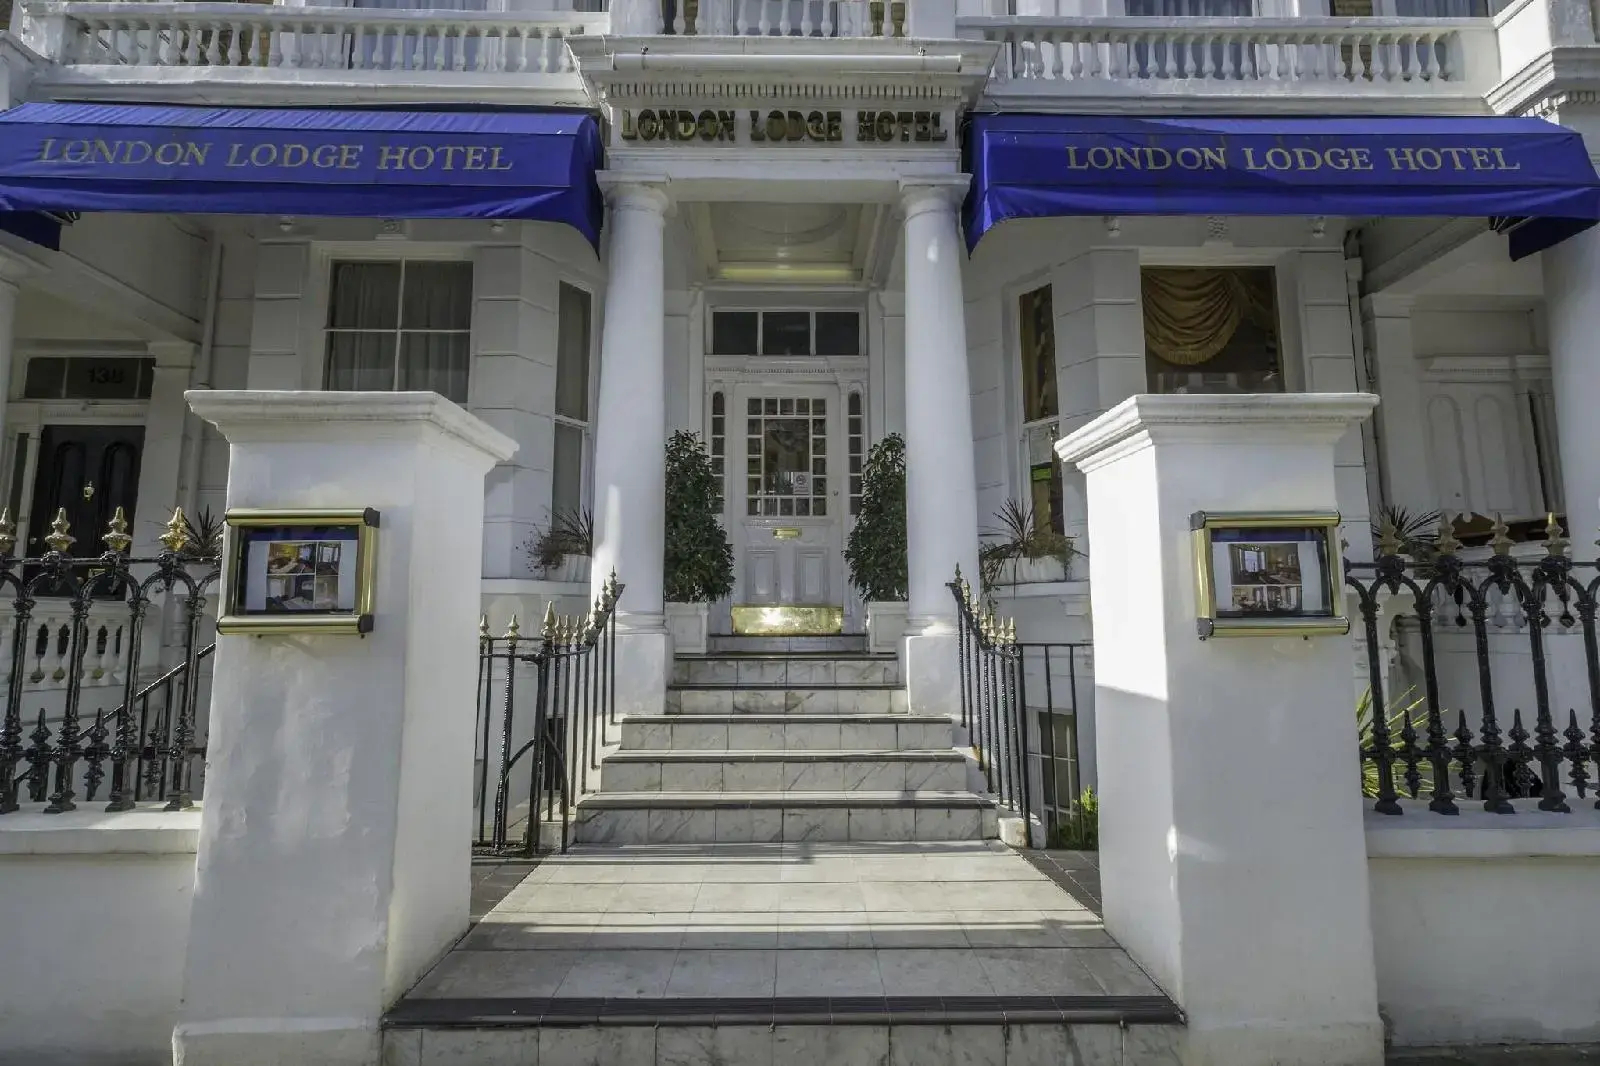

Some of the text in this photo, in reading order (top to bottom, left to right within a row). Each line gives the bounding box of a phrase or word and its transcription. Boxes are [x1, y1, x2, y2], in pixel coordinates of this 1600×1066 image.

[621, 108, 948, 142] LONDON LODGE HOTEL
[40, 136, 514, 172] LONDON LODGE HOTEL
[1065, 145, 1522, 172] LONDON LODGE HOTEL
